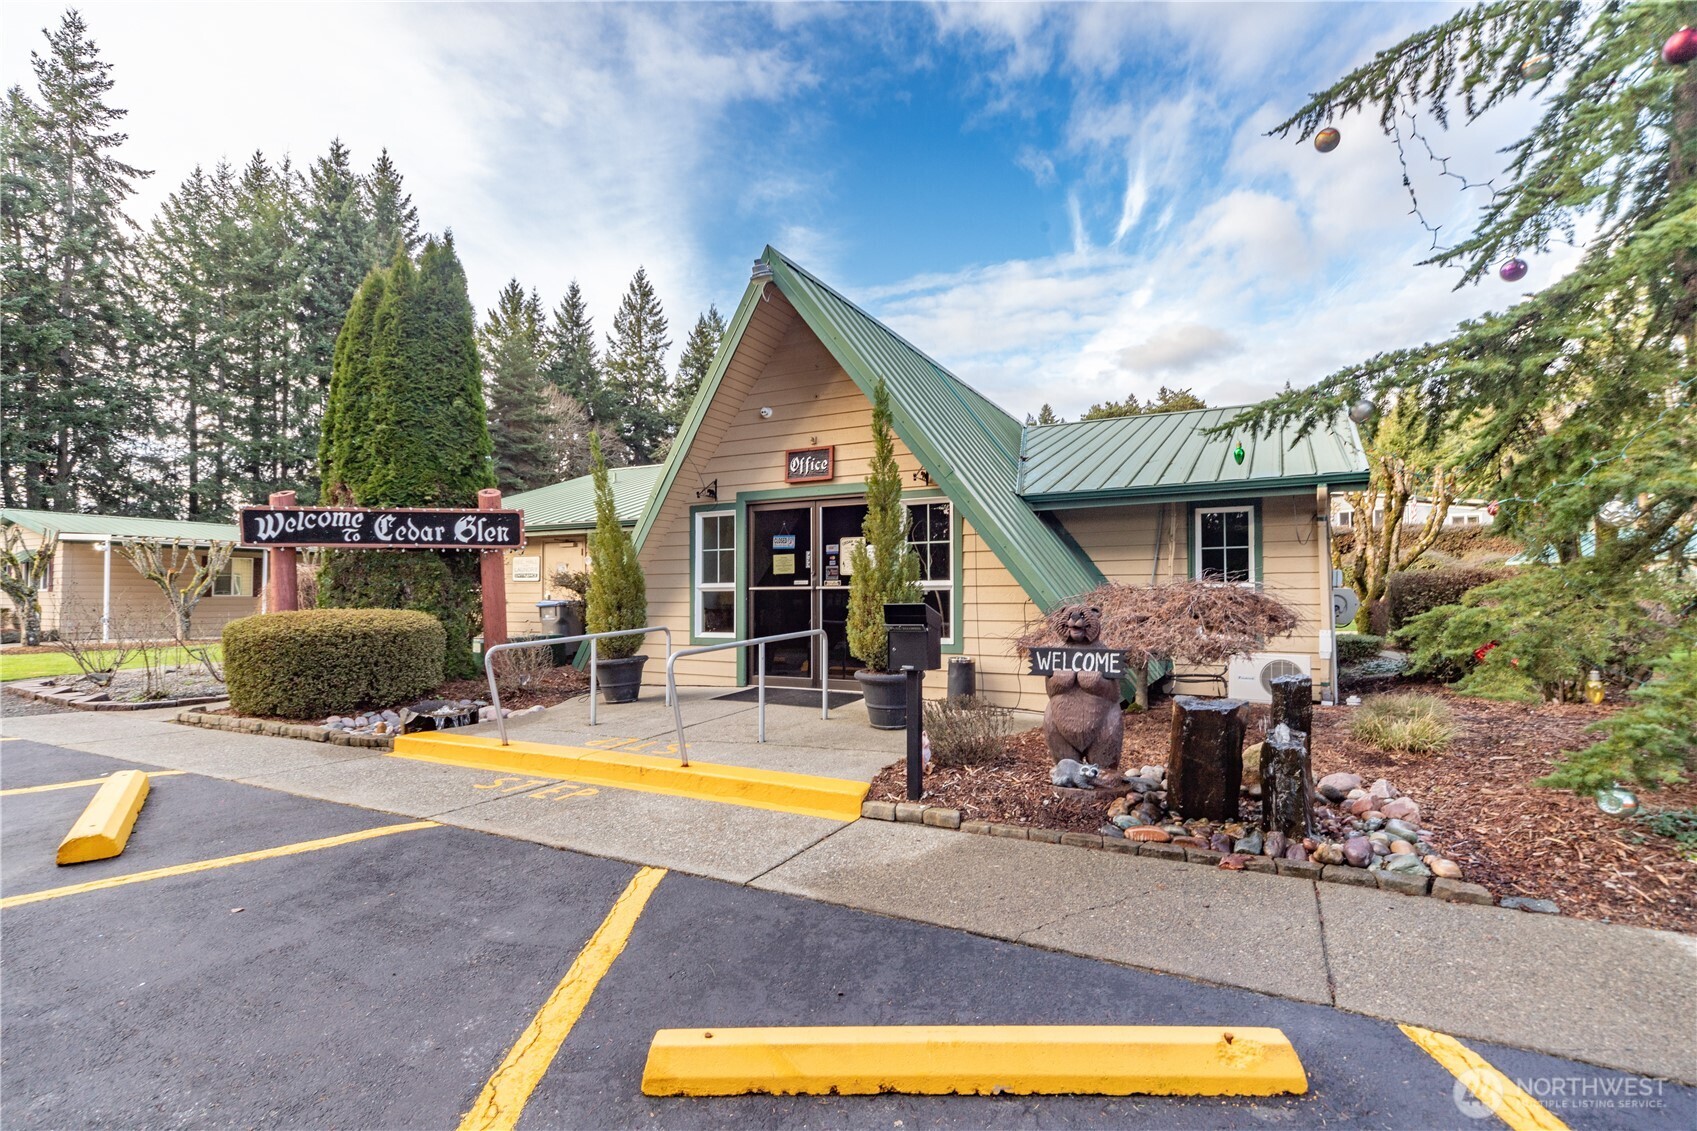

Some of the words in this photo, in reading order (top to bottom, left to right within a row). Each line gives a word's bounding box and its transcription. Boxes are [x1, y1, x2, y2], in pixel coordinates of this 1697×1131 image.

[790, 456, 828, 477] Office
[255, 511, 364, 541] Welcome
[342, 528, 360, 542] To
[373, 513, 446, 542] Cedar
[454, 515, 510, 543] Glen
[1036, 651, 1120, 673] WELCOME
[473, 777, 599, 800] STEP
